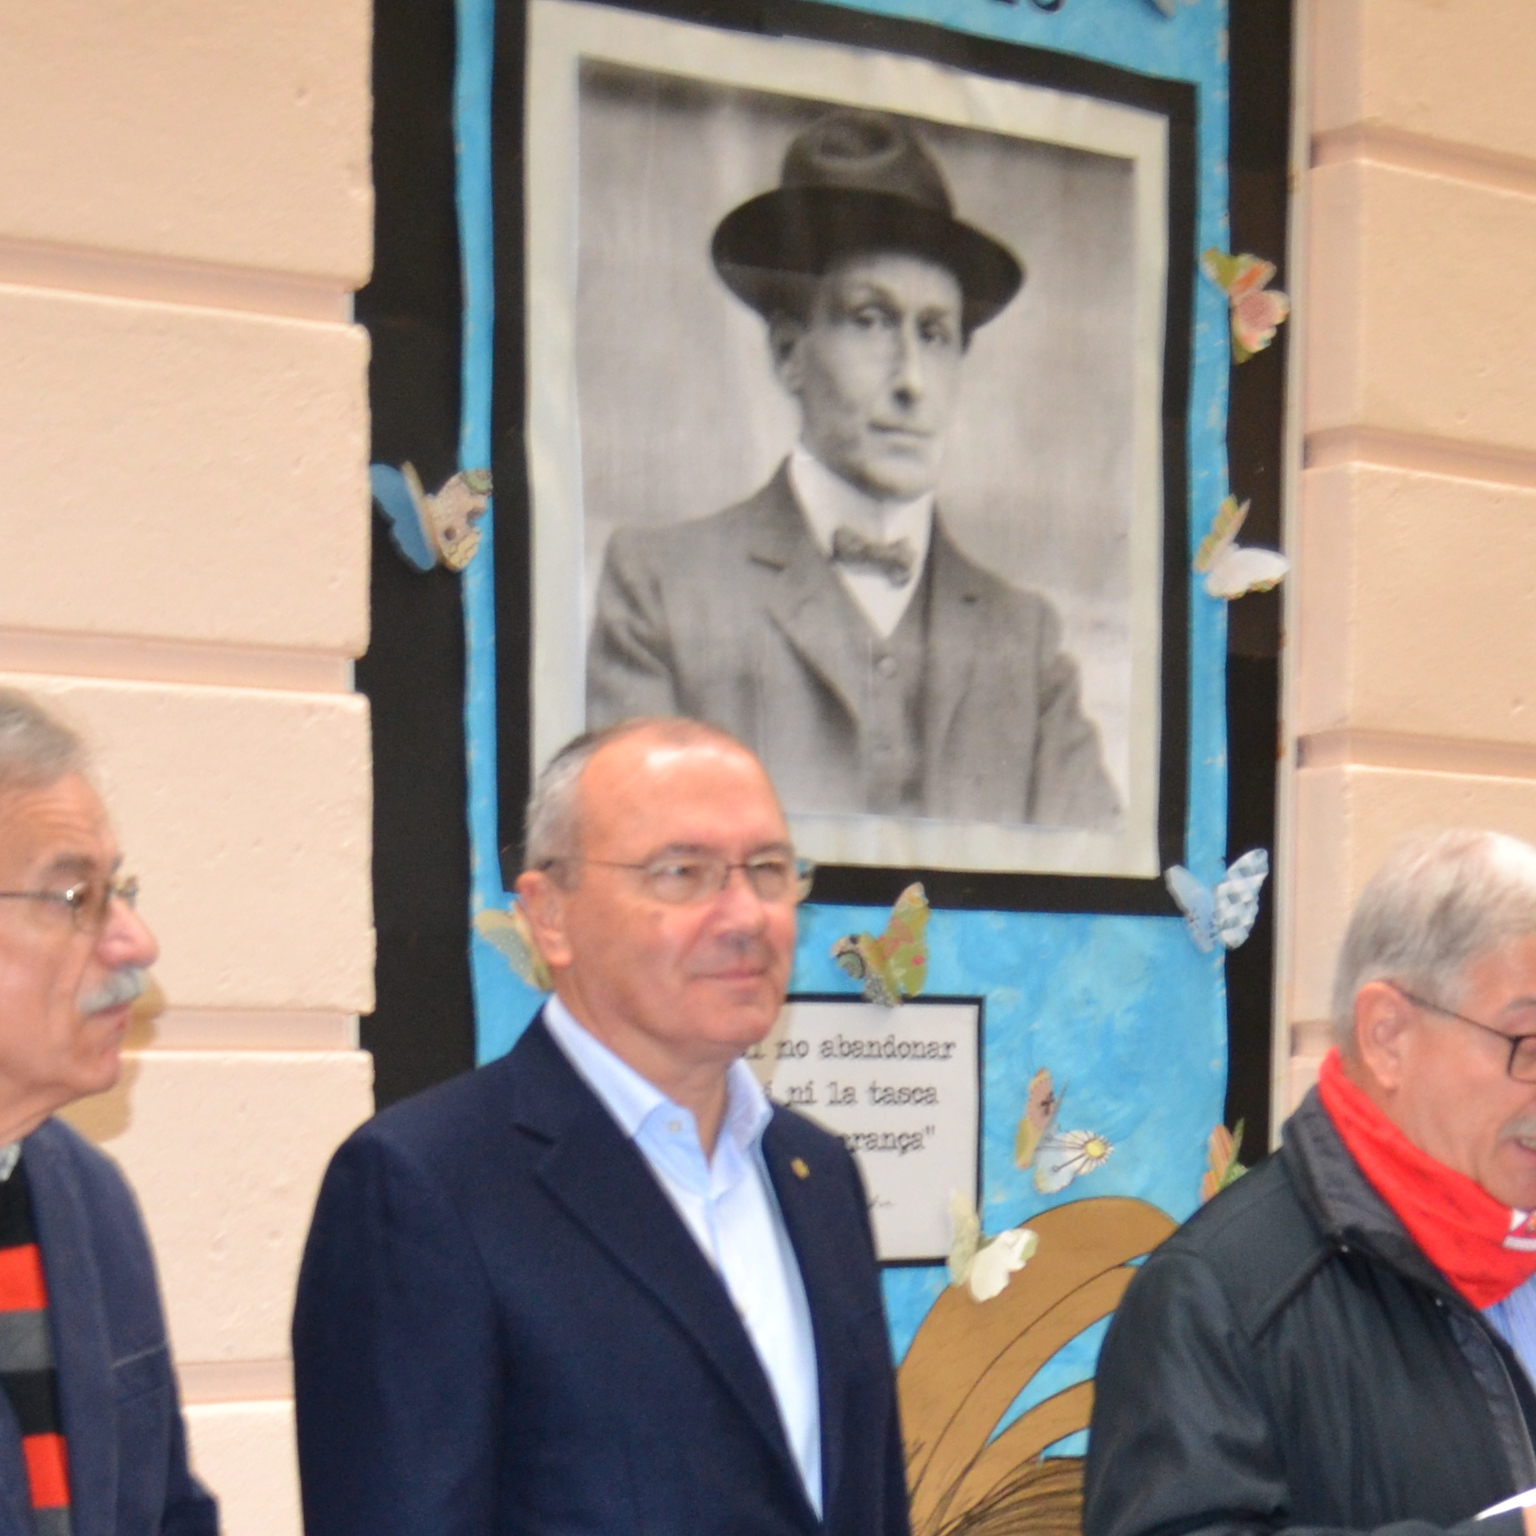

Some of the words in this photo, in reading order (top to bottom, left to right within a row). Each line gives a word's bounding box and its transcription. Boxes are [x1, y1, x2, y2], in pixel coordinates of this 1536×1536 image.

[775, 1038, 810, 1060] no
[819, 1034, 957, 1061] abandonar
[784, 1081, 817, 1107] ni
[827, 1081, 859, 1106] la
[867, 1081, 940, 1106] tasca
